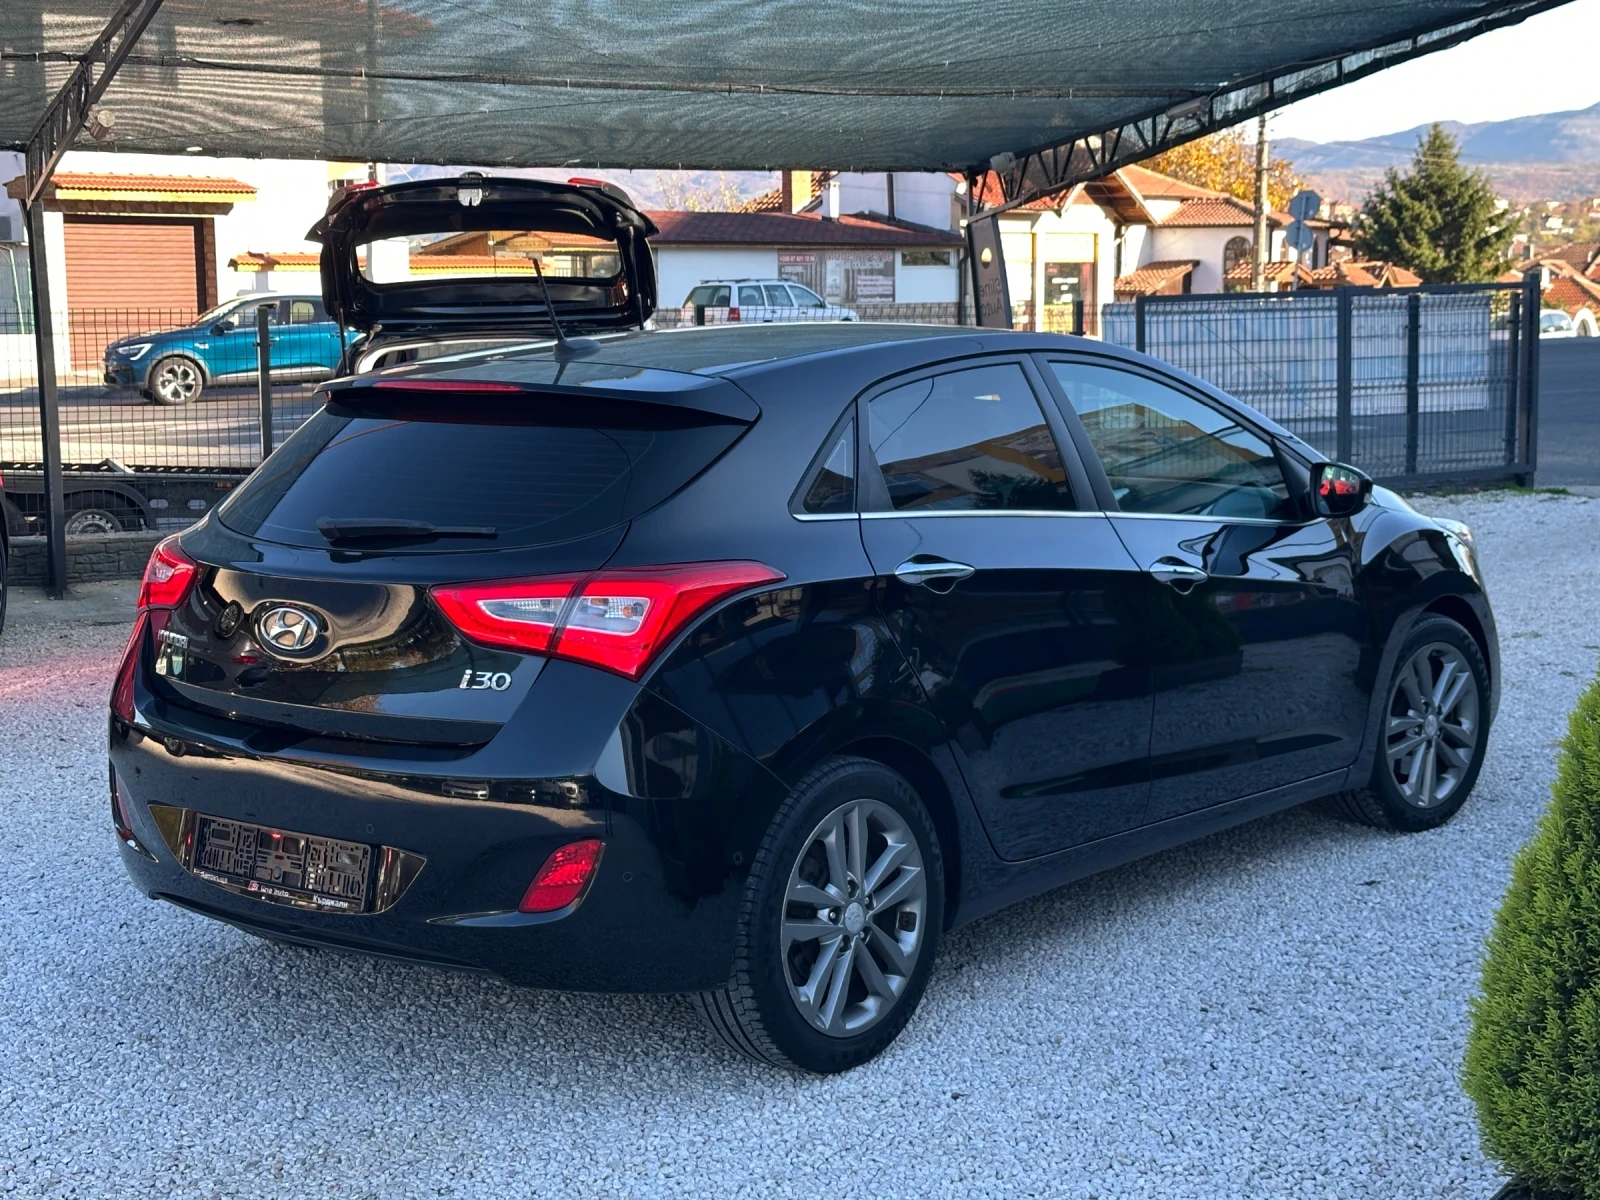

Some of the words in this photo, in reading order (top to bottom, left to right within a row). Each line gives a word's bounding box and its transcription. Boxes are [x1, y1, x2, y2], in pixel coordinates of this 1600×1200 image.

[459, 669, 511, 691] i30
[273, 888, 290, 898] auto
[312, 894, 349, 909] Кърджали
